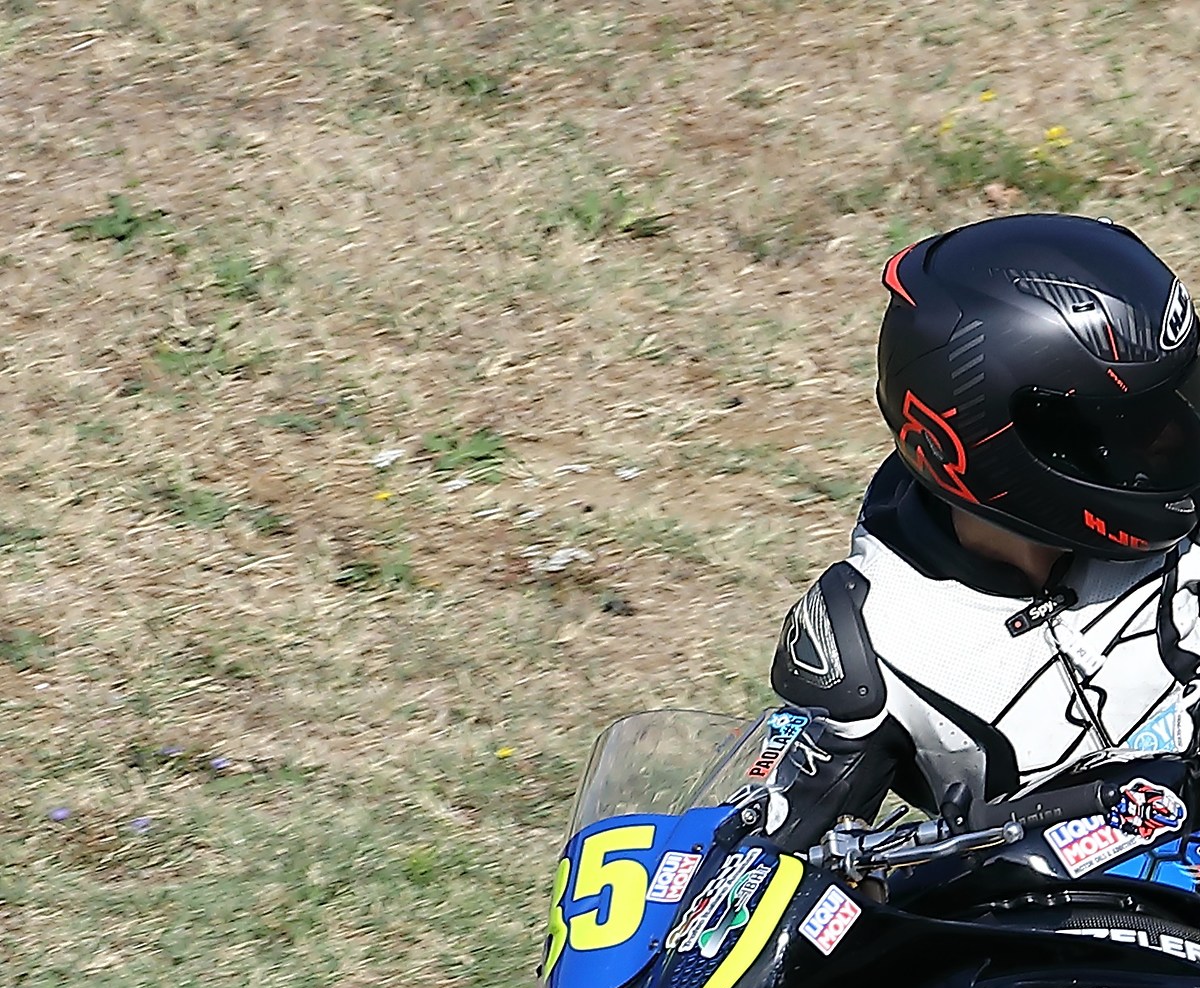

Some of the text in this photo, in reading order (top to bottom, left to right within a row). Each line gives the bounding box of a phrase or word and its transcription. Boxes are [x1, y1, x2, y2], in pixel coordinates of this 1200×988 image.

[1029, 599, 1058, 621] Spy
[1052, 815, 1105, 846] LIQUI
[1065, 825, 1116, 862] MOLY
[652, 854, 683, 897] LIQUI
[667, 856, 698, 898] MOLY
[804, 889, 847, 939] LIQUI
[816, 901, 858, 950] MOLY
